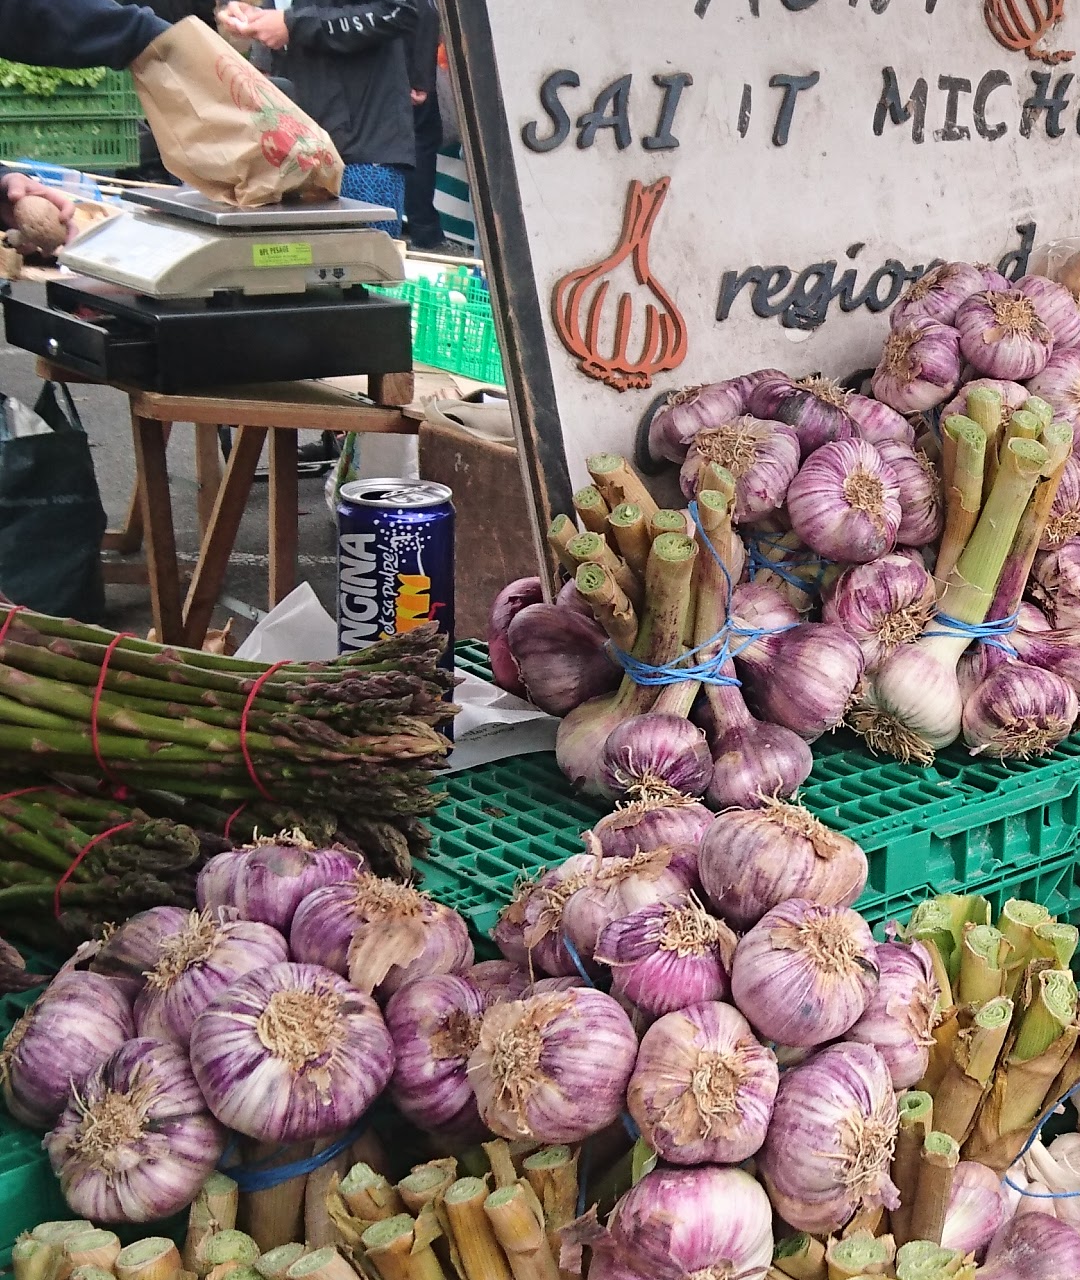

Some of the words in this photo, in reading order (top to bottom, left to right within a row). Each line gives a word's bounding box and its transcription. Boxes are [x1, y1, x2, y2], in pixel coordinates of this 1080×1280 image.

[327, 12, 376, 35] JUST
[377, 544, 399, 598] pulpe!
[339, 533, 380, 654] NGINA
[382, 599, 395, 617] sa
[378, 616, 395, 635] et
